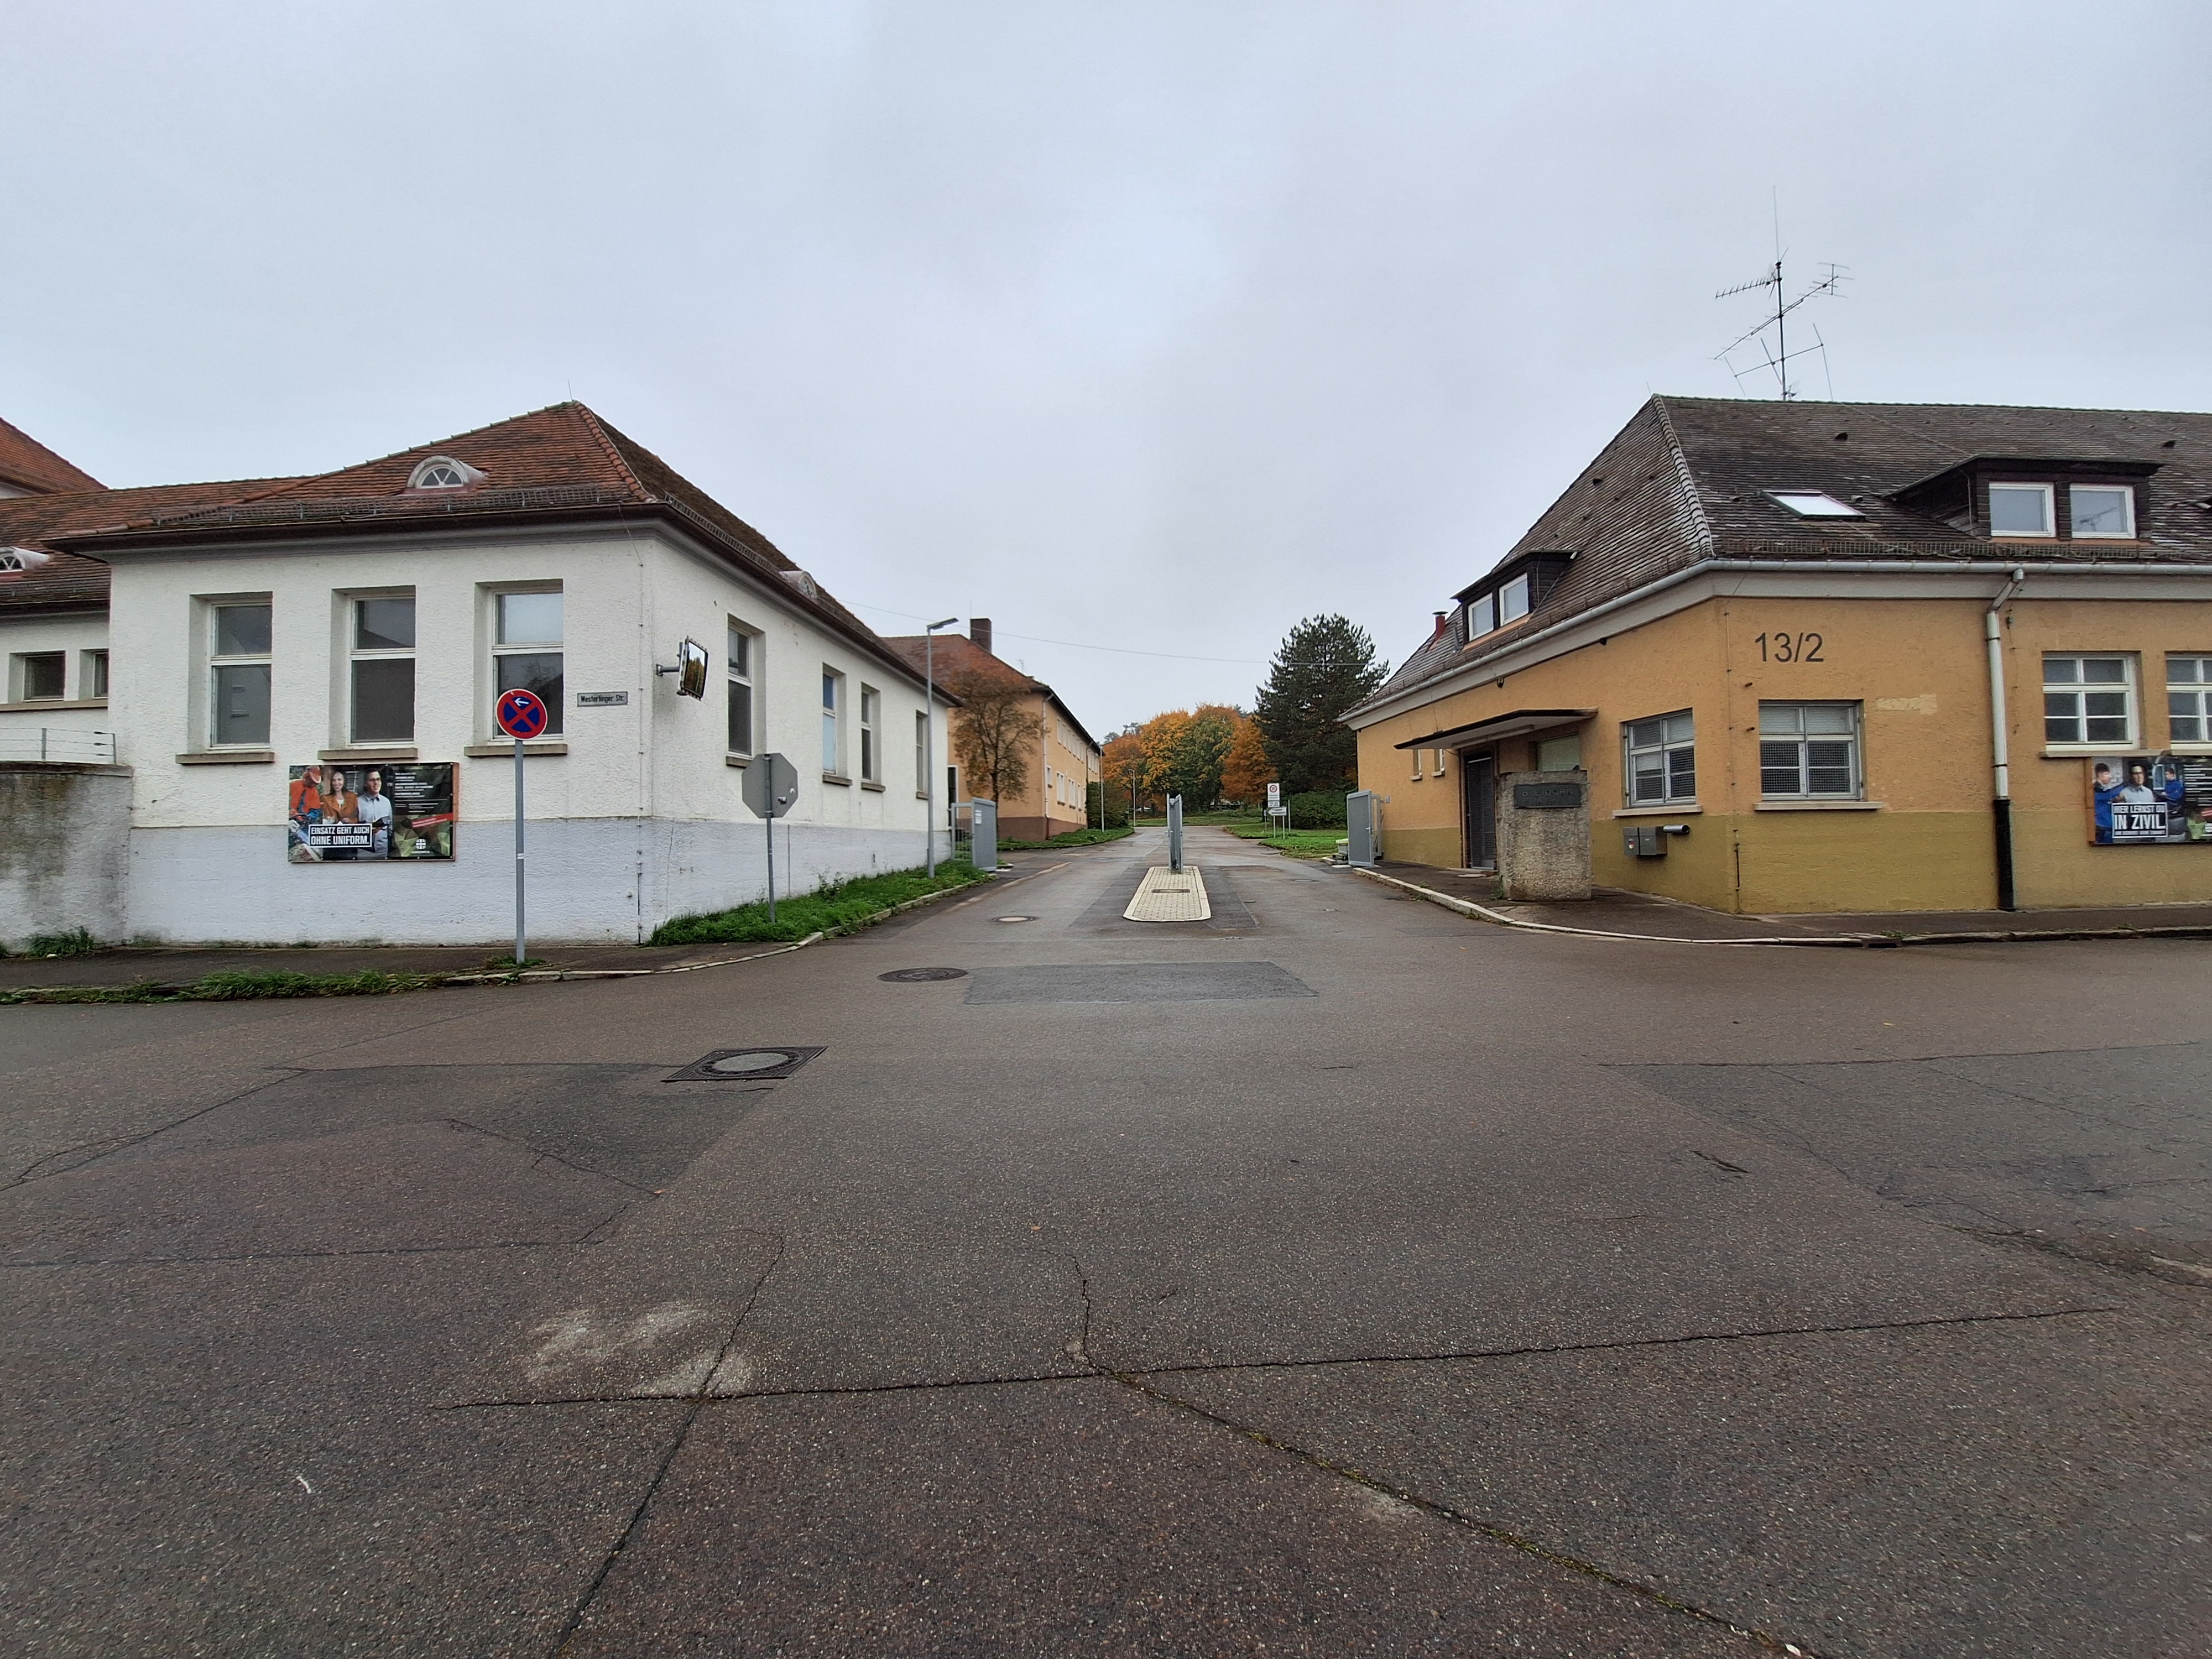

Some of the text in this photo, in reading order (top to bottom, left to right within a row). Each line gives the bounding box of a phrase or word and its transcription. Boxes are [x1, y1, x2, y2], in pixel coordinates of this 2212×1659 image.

[1755, 632, 1824, 662] 13/2
[2115, 814, 2166, 830] IN ZIVIL
[311, 836, 369, 845] OHNE UNIFORM.
